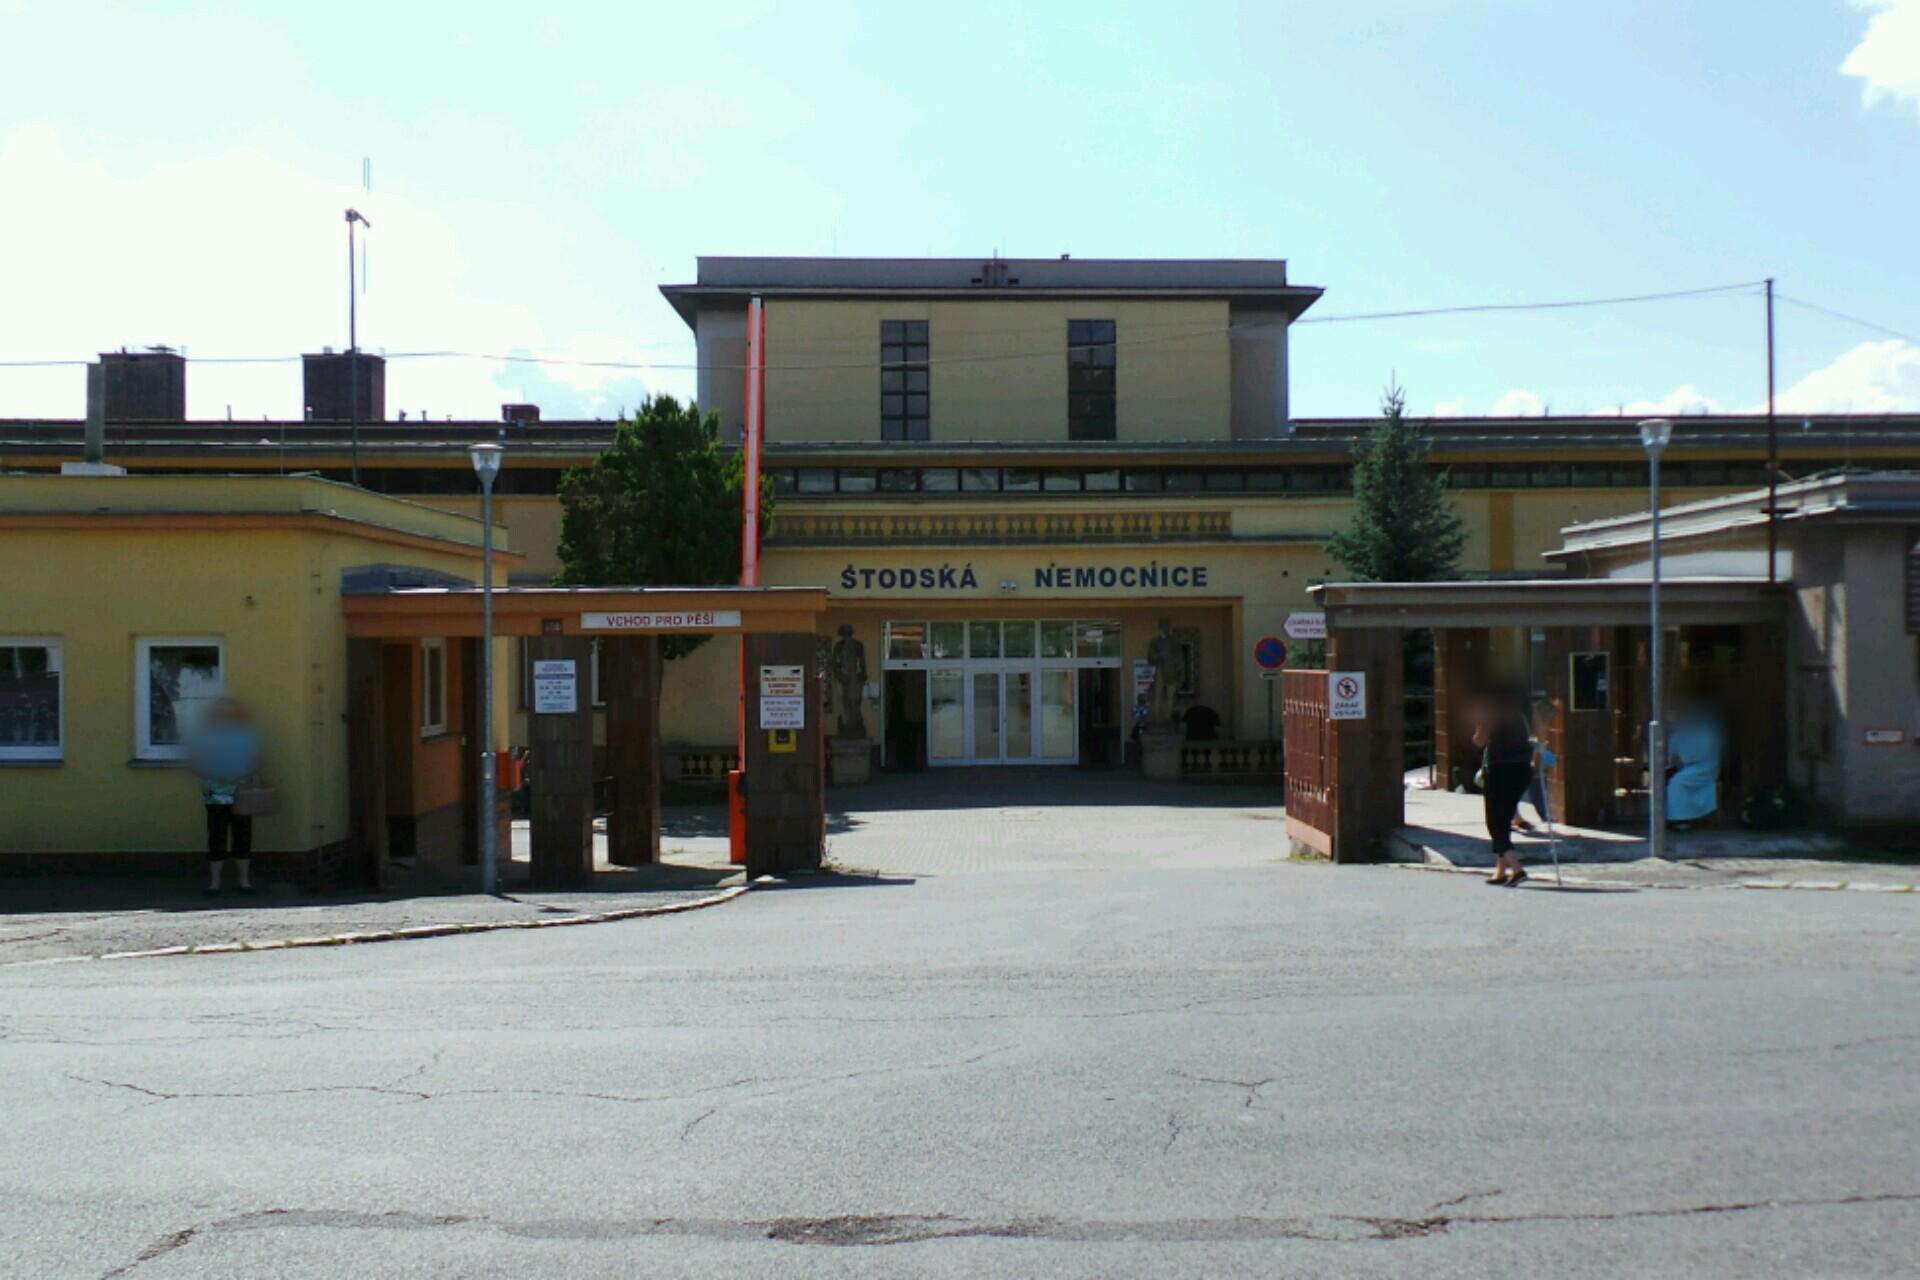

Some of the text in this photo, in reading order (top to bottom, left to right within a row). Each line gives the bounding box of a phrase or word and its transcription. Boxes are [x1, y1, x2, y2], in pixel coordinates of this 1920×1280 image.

[841, 563, 1208, 589] ŠTODSKÁ NEMOCNICE
[606, 612, 714, 627] VCHOD PRO PĚŠÍ
